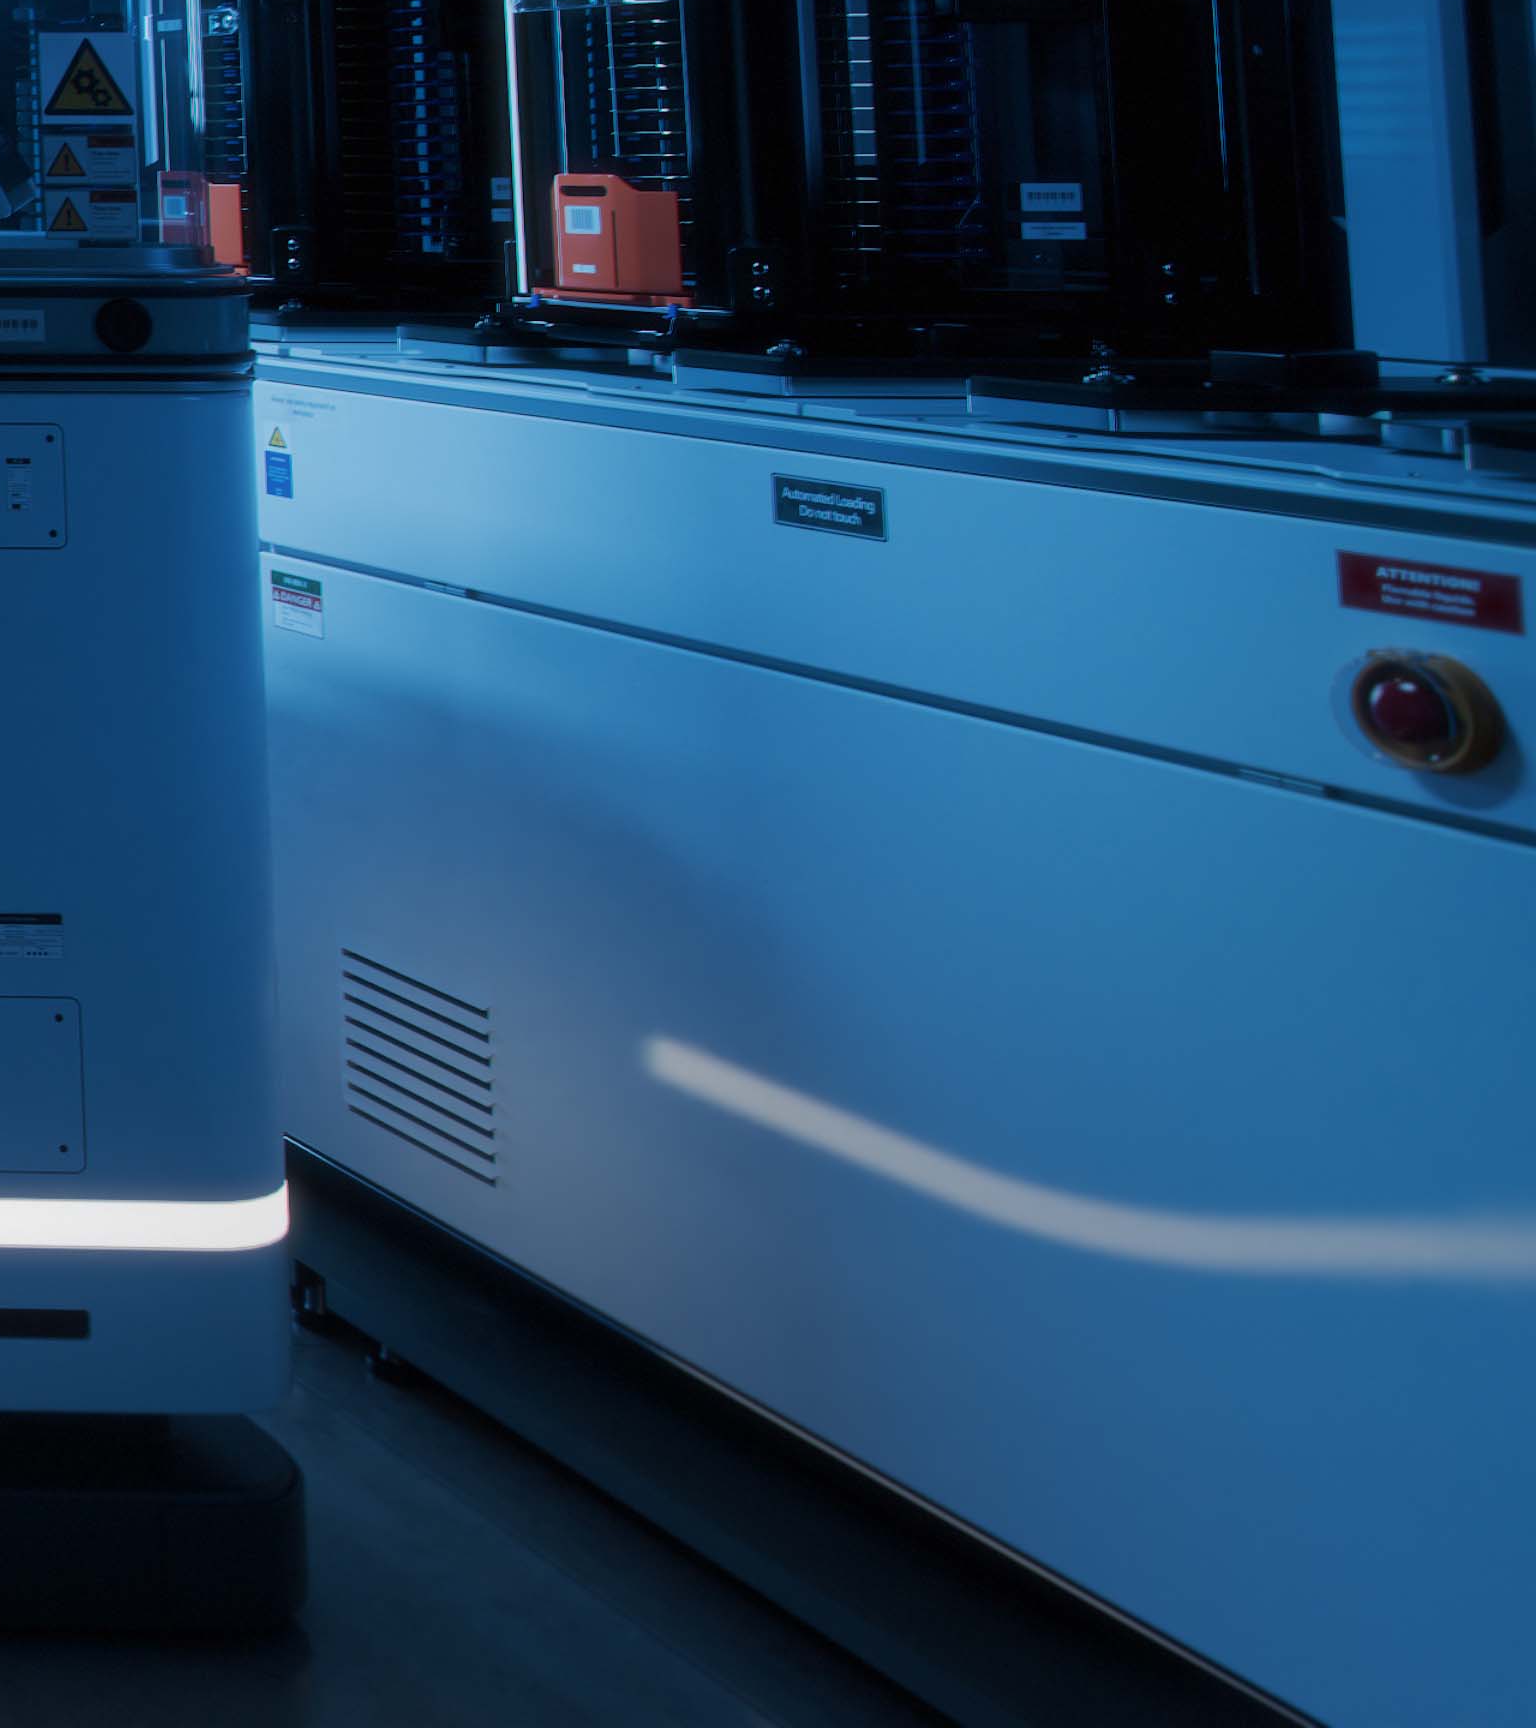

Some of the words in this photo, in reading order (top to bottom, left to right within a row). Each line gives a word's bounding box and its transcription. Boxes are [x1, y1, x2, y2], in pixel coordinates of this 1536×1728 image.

[781, 485, 835, 506] Automated
[836, 494, 876, 515] Loading
[799, 503, 814, 518] Do
[815, 509, 830, 521] not
[832, 510, 863, 528] touch
